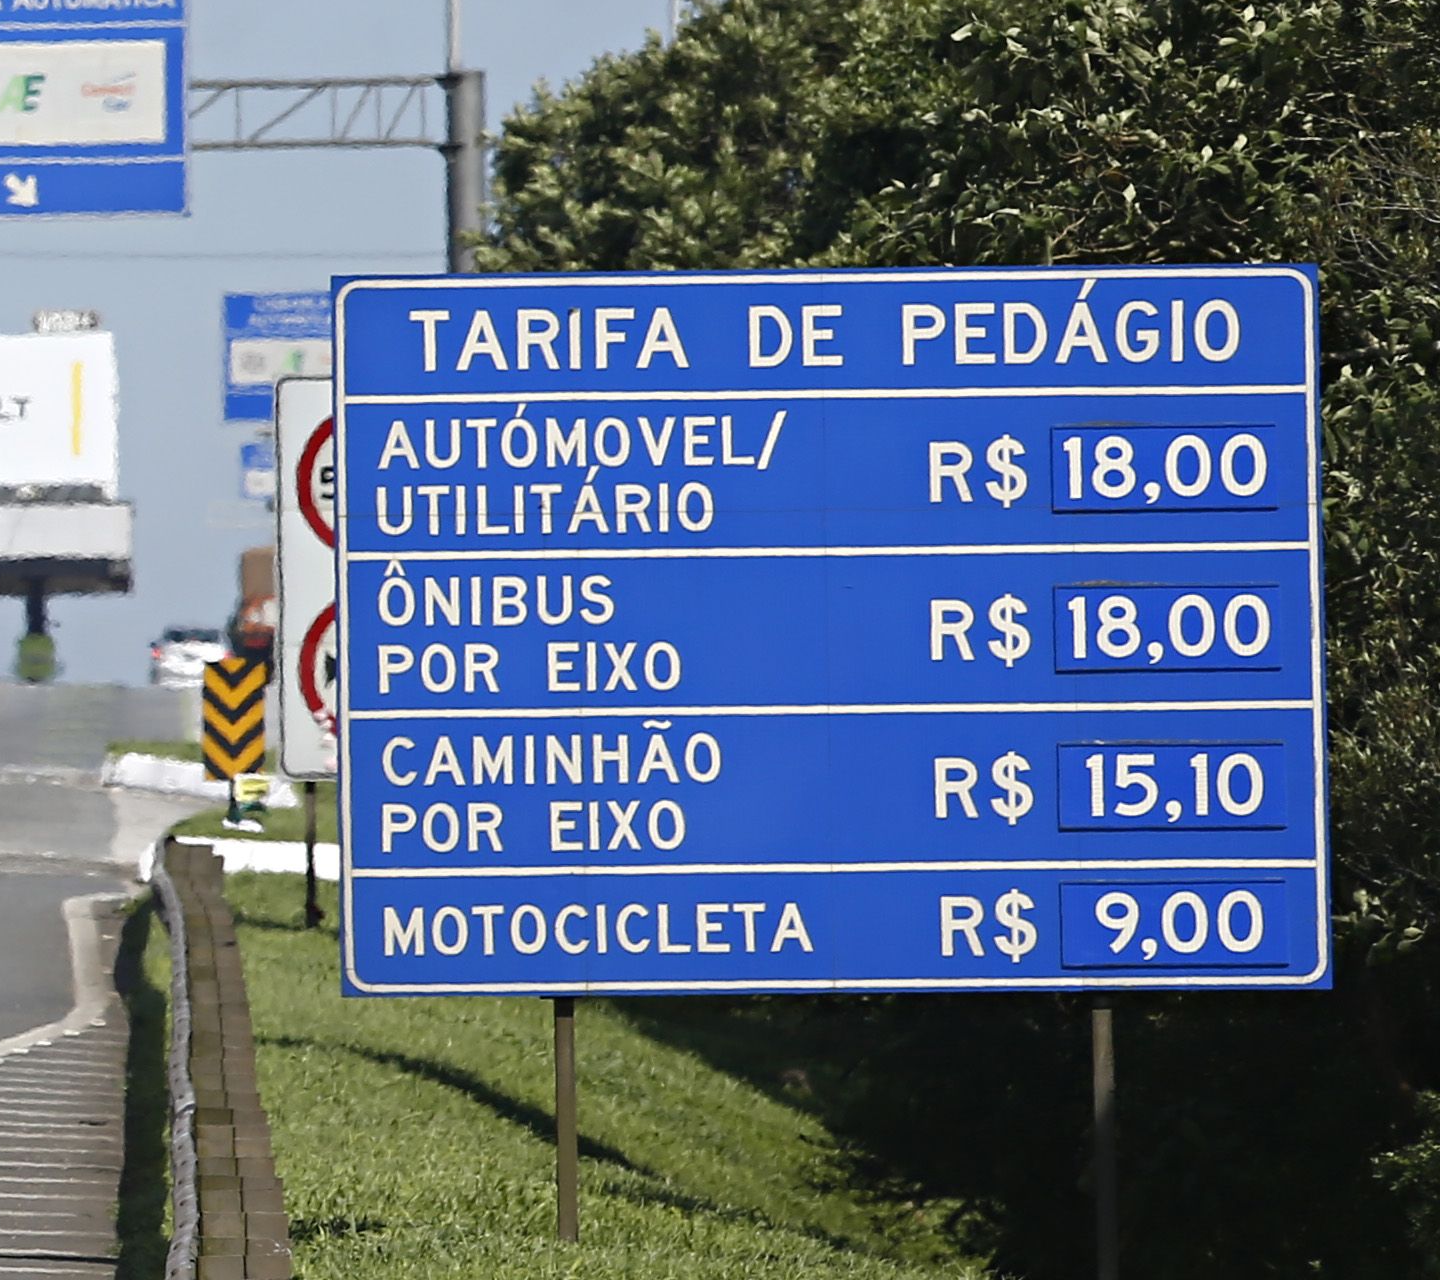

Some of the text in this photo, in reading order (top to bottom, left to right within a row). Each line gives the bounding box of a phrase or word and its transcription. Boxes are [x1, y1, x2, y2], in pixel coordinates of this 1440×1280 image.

[408, 306, 690, 372] TARIFA
[747, 304, 845, 368] DE
[900, 277, 1241, 367] PEDÁGIO
[377, 403, 788, 471] AUTÓMOVEL/
[927, 433, 1268, 509] R$ 18,00
[375, 465, 715, 536] UTILITÁRIO
[377, 559, 616, 627] ÔNIBUS
[929, 592, 1272, 668] R$ 18,00
[377, 641, 682, 695] POR EIXO
[381, 719, 723, 787] CAMINHÃO
[932, 750, 1266, 826] R$ 15,10
[381, 799, 687, 853] POR EIXO
[383, 902, 815, 957] MOTOCICLETA
[939, 887, 1266, 963] R$ 9,00
